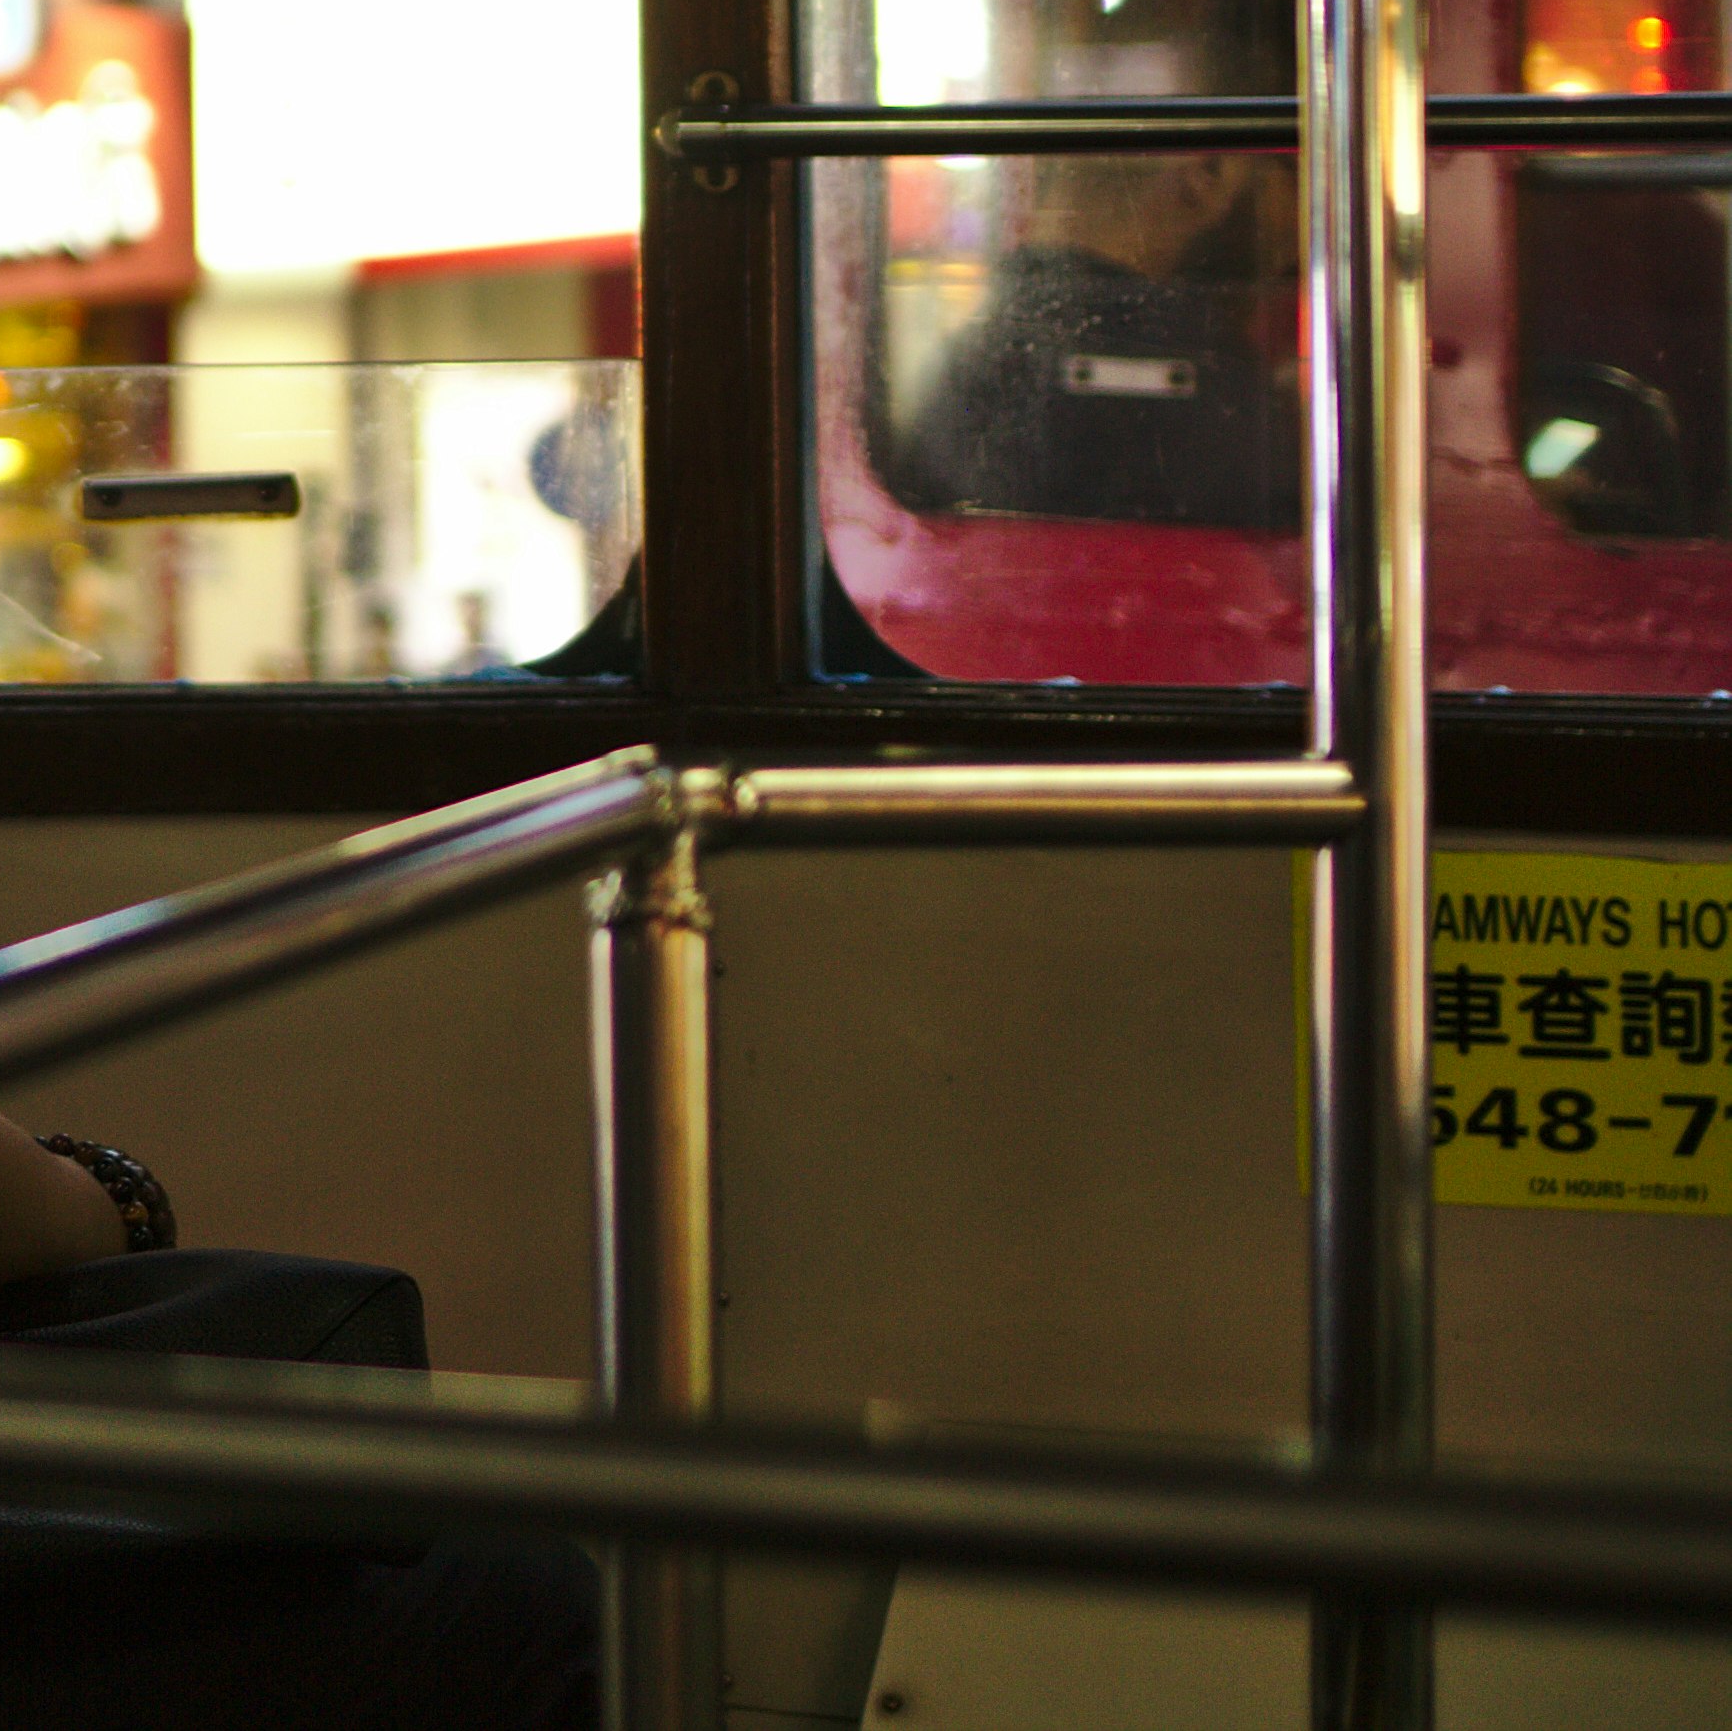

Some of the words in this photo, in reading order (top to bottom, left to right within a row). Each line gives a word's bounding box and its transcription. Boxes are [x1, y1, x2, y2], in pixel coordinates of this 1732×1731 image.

[1434, 893, 1632, 948] AMWAYS
[1658, 898, 1732, 951] HO
[1431, 963, 1732, 1065] 車查詢
